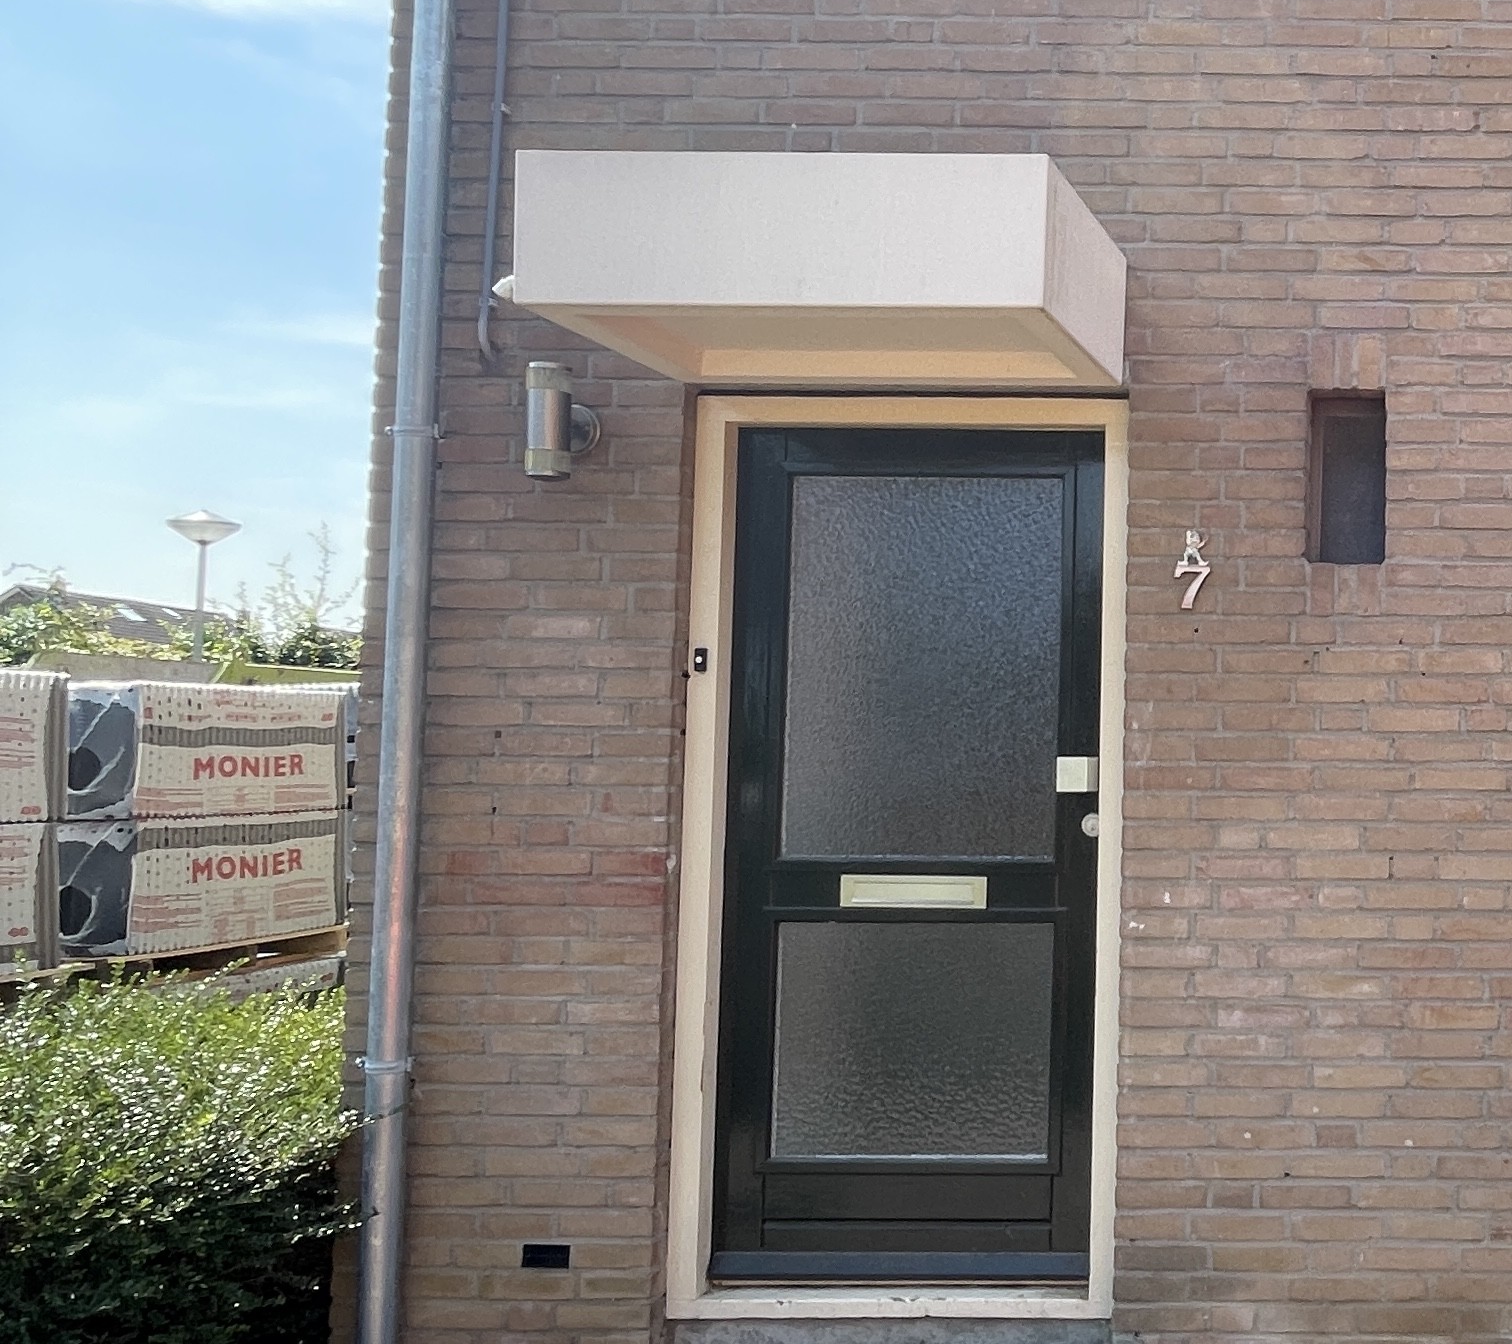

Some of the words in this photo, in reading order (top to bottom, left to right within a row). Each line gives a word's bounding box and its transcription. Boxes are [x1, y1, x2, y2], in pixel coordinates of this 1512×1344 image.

[1173, 561, 1211, 610] 7
[193, 754, 304, 781] MONIER
[192, 848, 303, 884] MONIER
